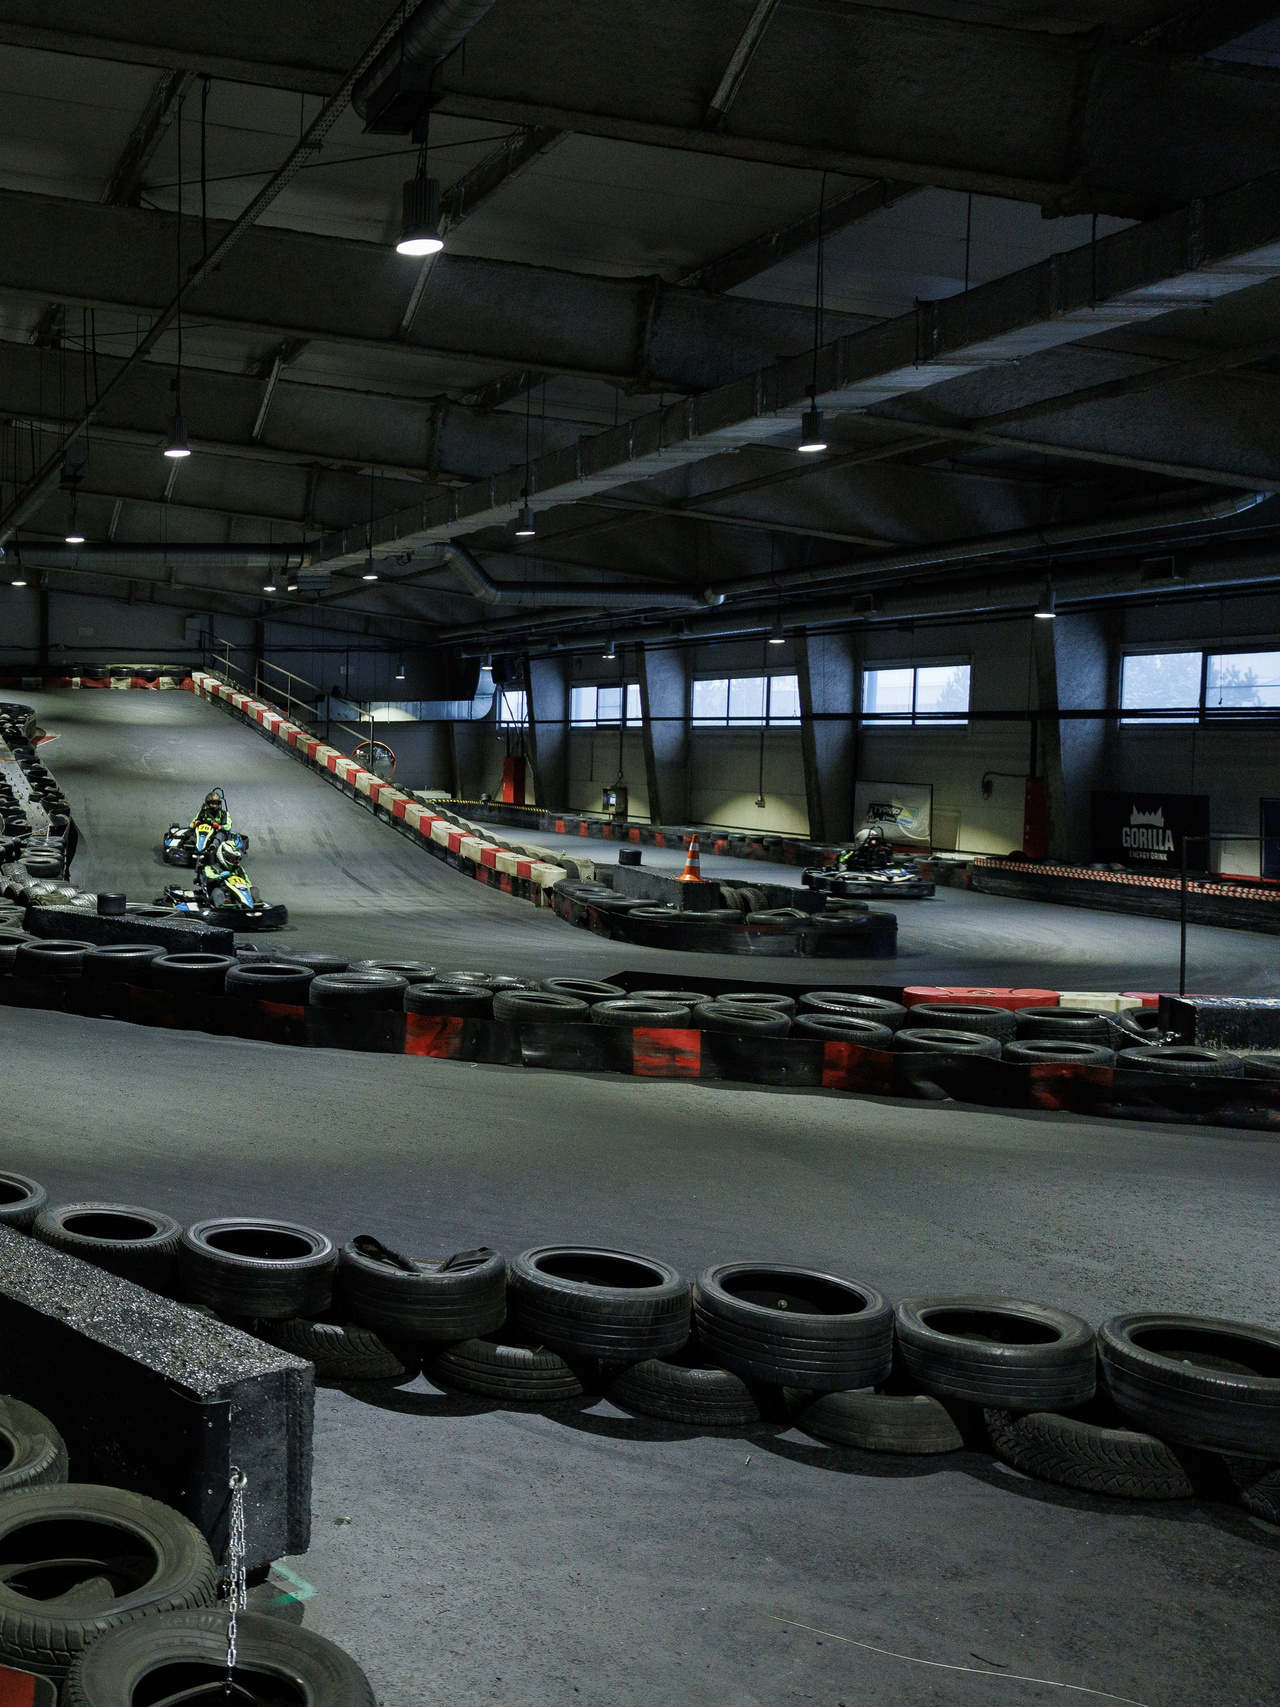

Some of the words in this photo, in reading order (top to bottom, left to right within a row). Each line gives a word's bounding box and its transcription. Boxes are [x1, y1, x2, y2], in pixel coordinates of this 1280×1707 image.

[1122, 827, 1175, 851] GORILLA
[1129, 850, 1150, 859] ENERGY
[1151, 852, 1168, 860] DRINK
